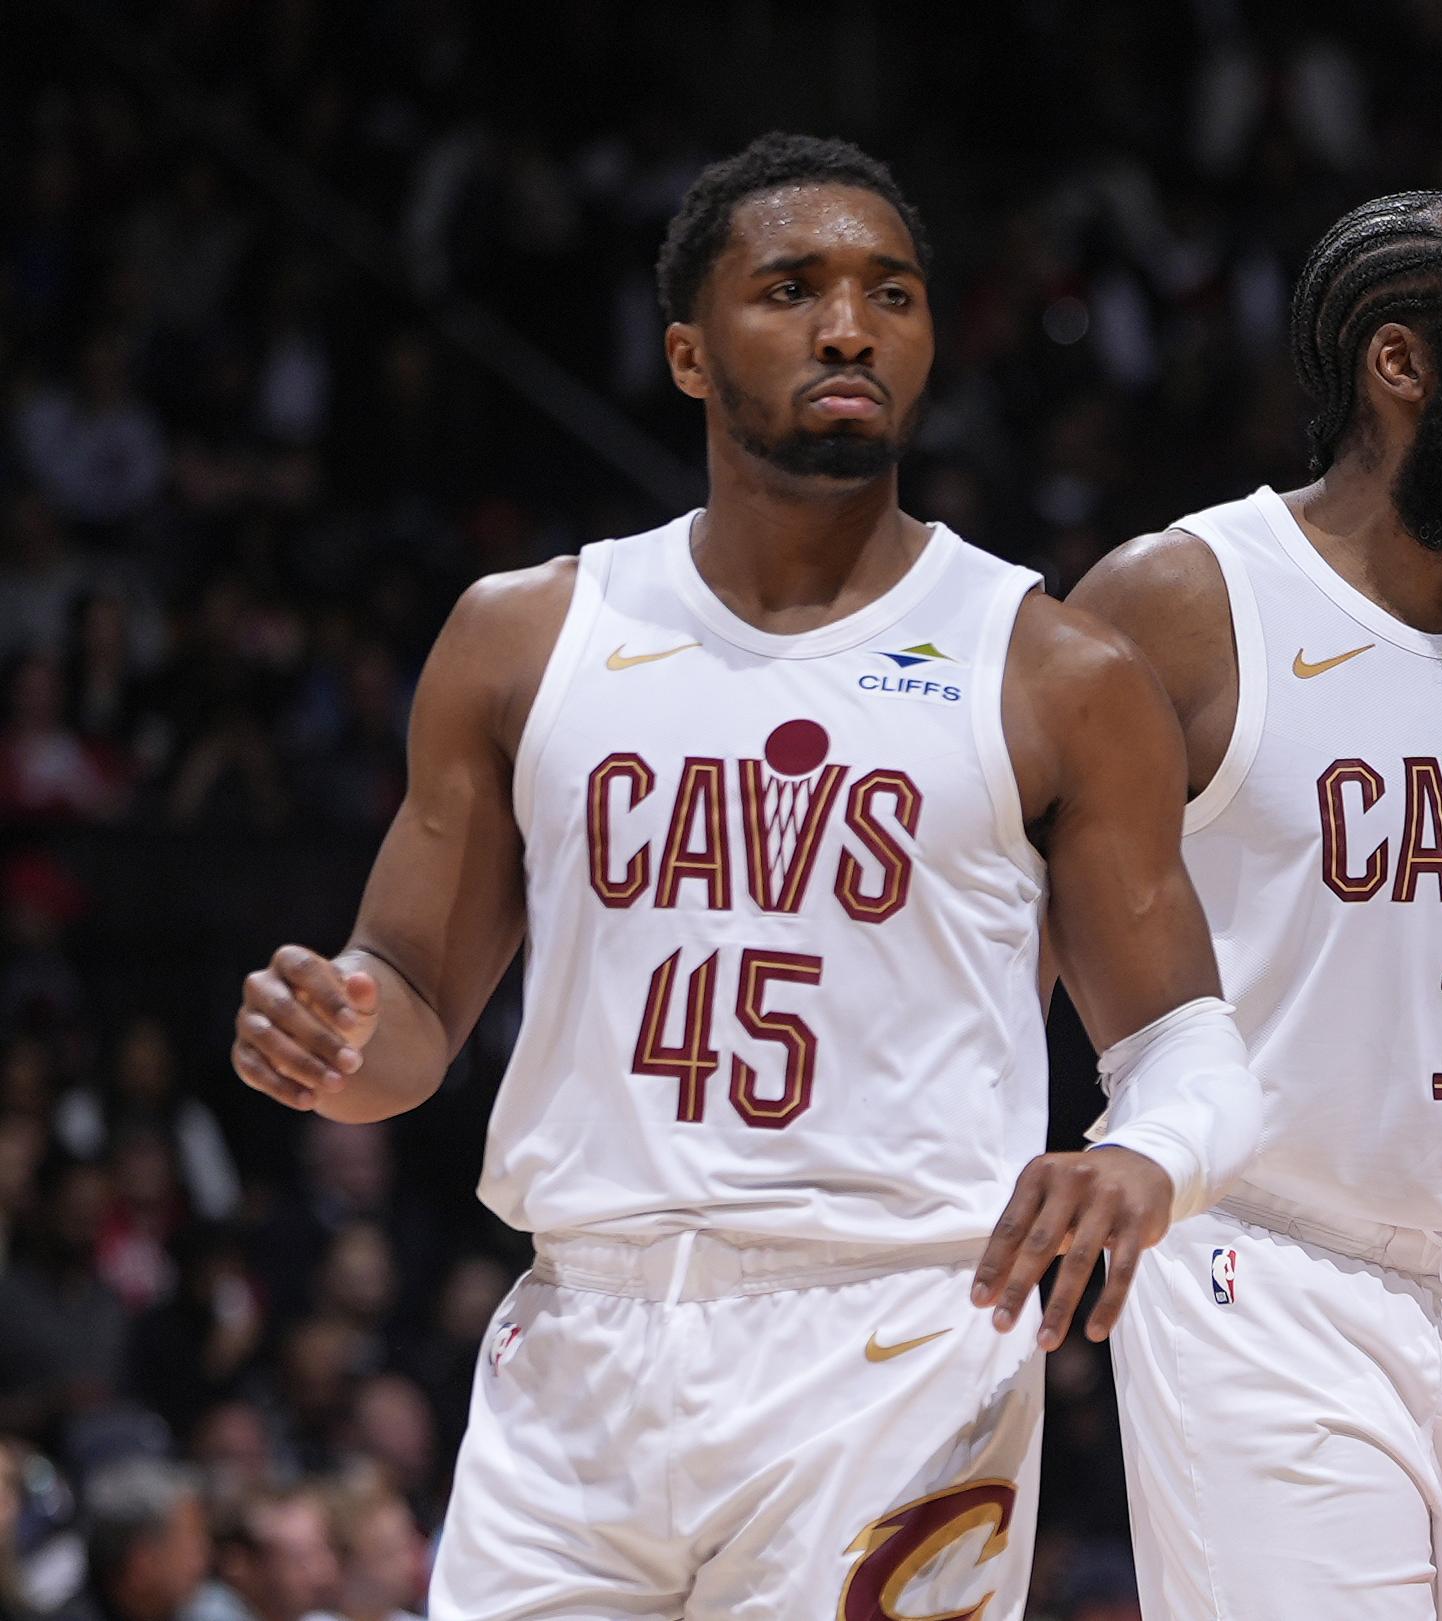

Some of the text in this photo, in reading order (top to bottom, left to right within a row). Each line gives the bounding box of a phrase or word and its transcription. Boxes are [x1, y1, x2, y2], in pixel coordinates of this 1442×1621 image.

[858, 674, 962, 702] CLIFFS
[586, 751, 924, 925] CAVS
[631, 947, 824, 1130] 45
